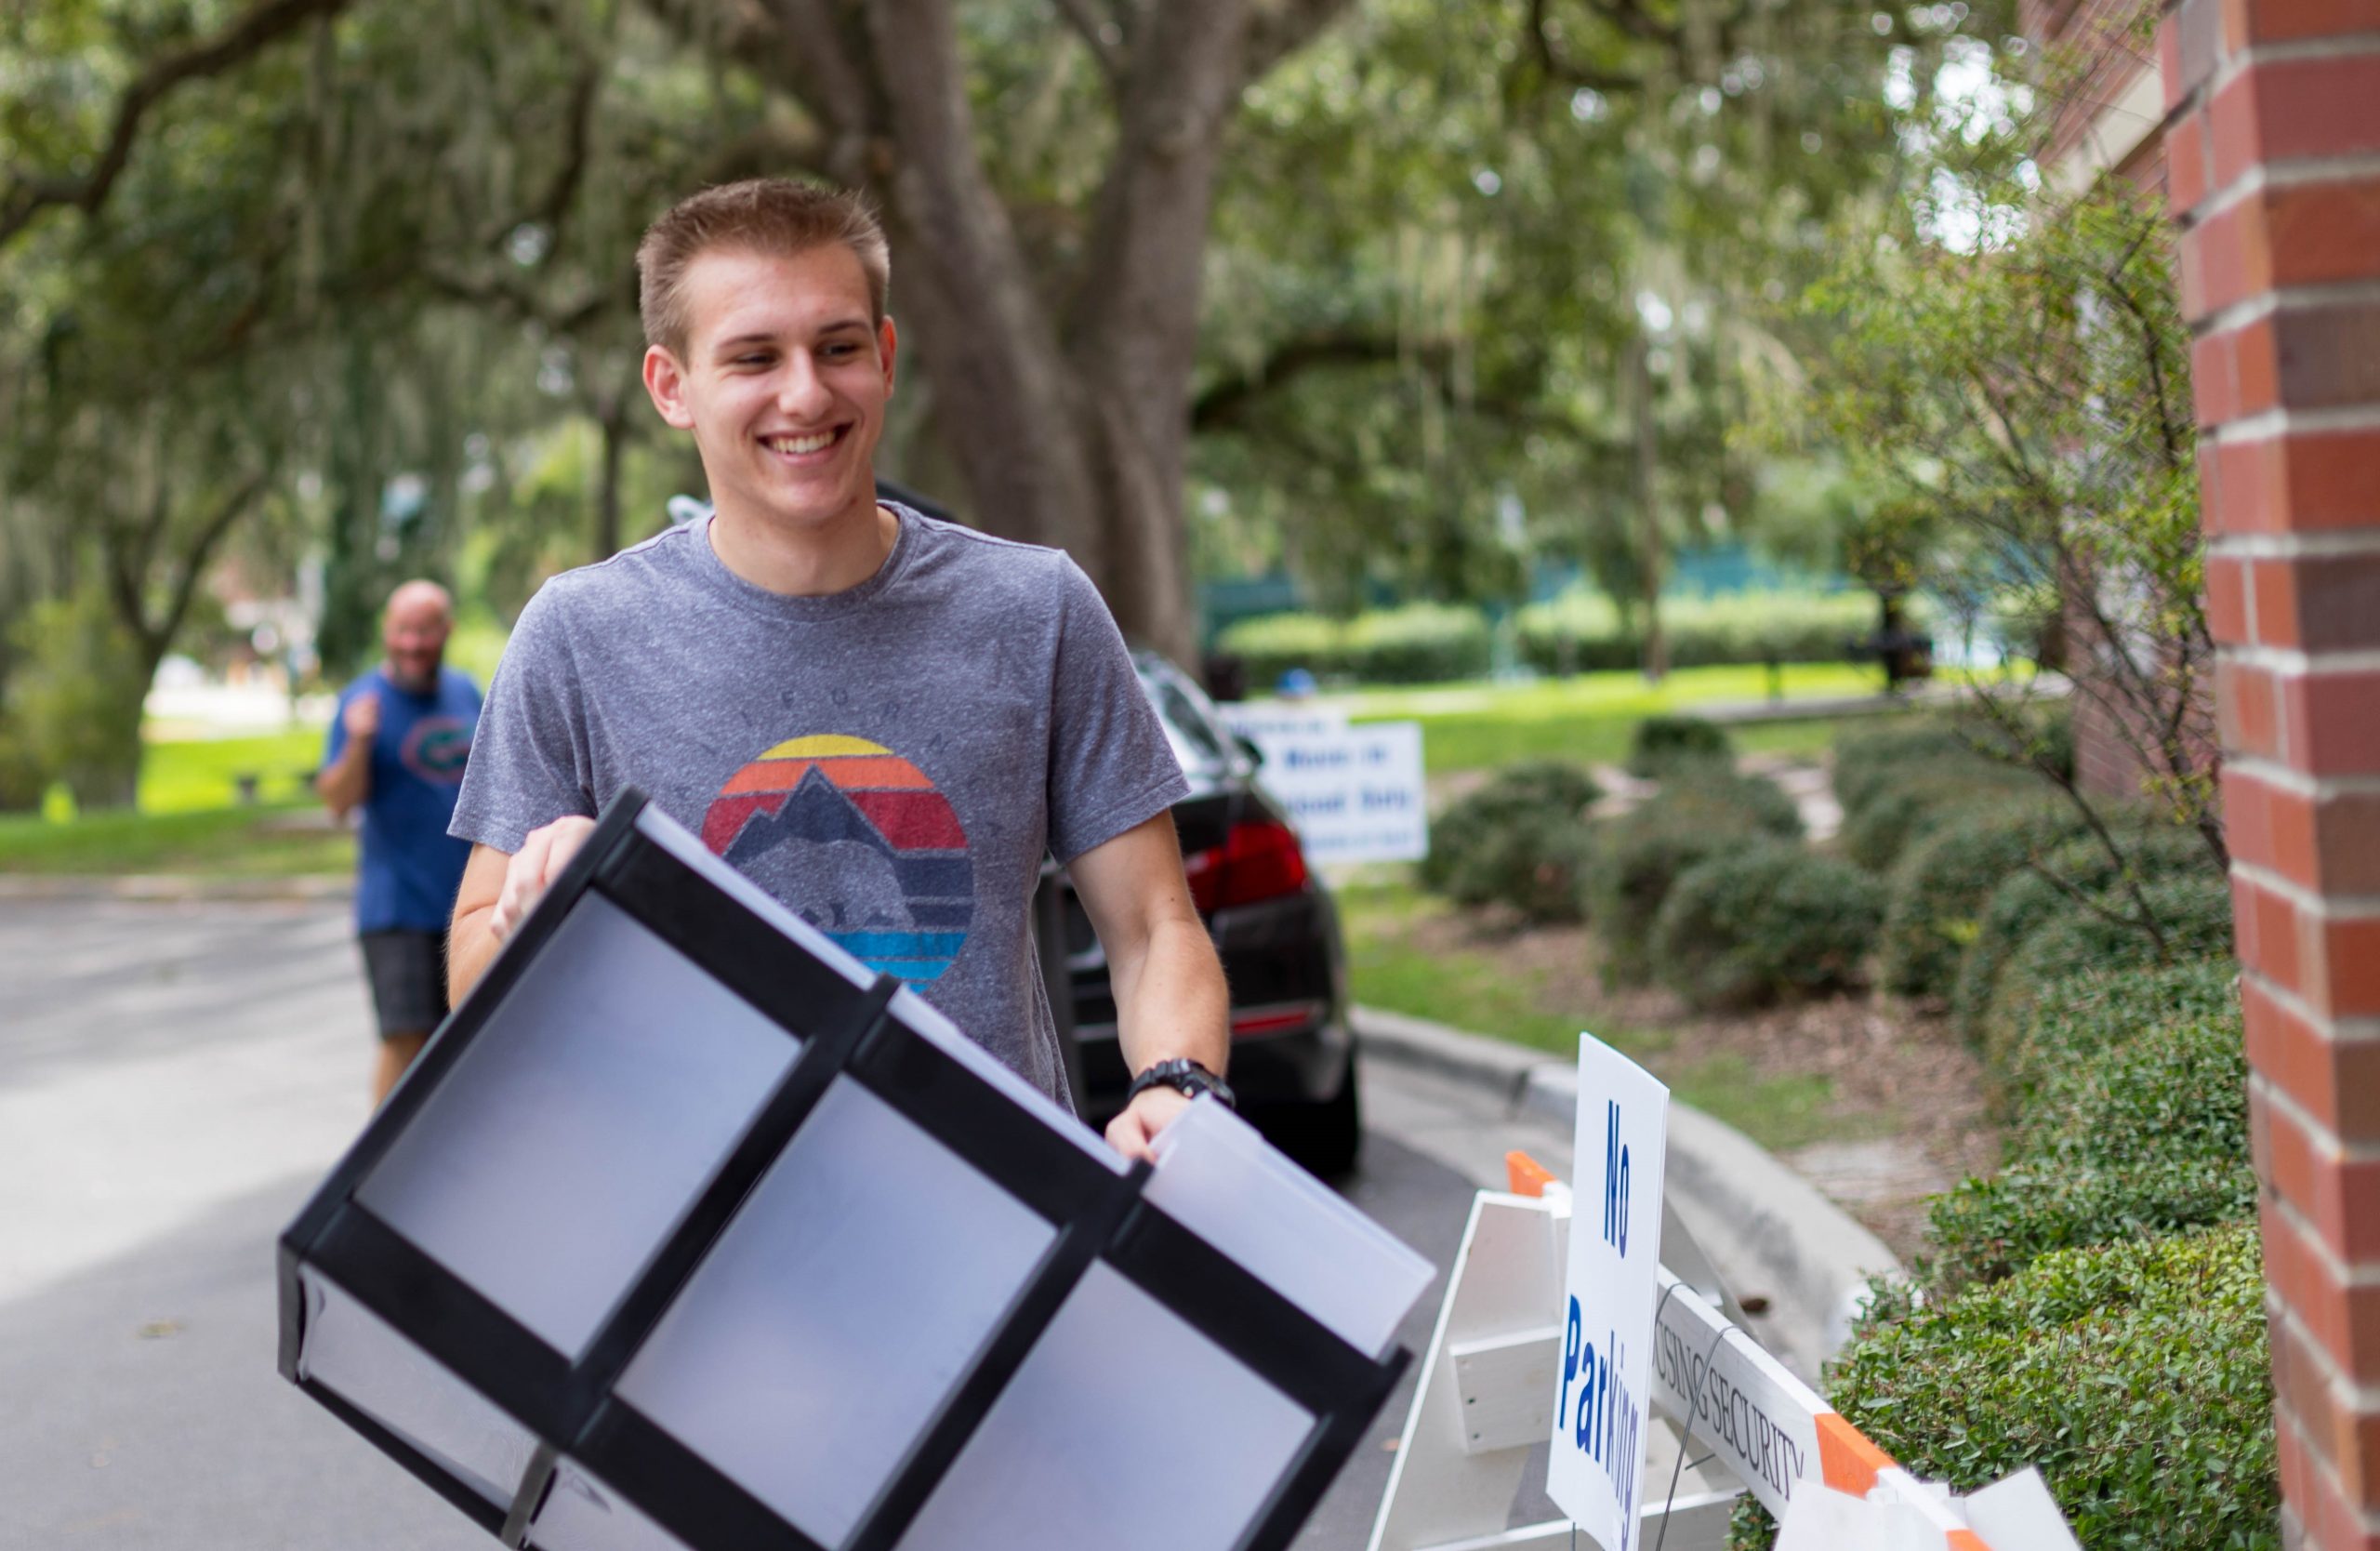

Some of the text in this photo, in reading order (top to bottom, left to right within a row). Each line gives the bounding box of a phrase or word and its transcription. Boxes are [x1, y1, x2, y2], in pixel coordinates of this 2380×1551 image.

[1604, 1098, 1630, 1259] No
[1558, 1293, 1638, 1551] Parking
[1652, 1320, 1709, 1421] USING
